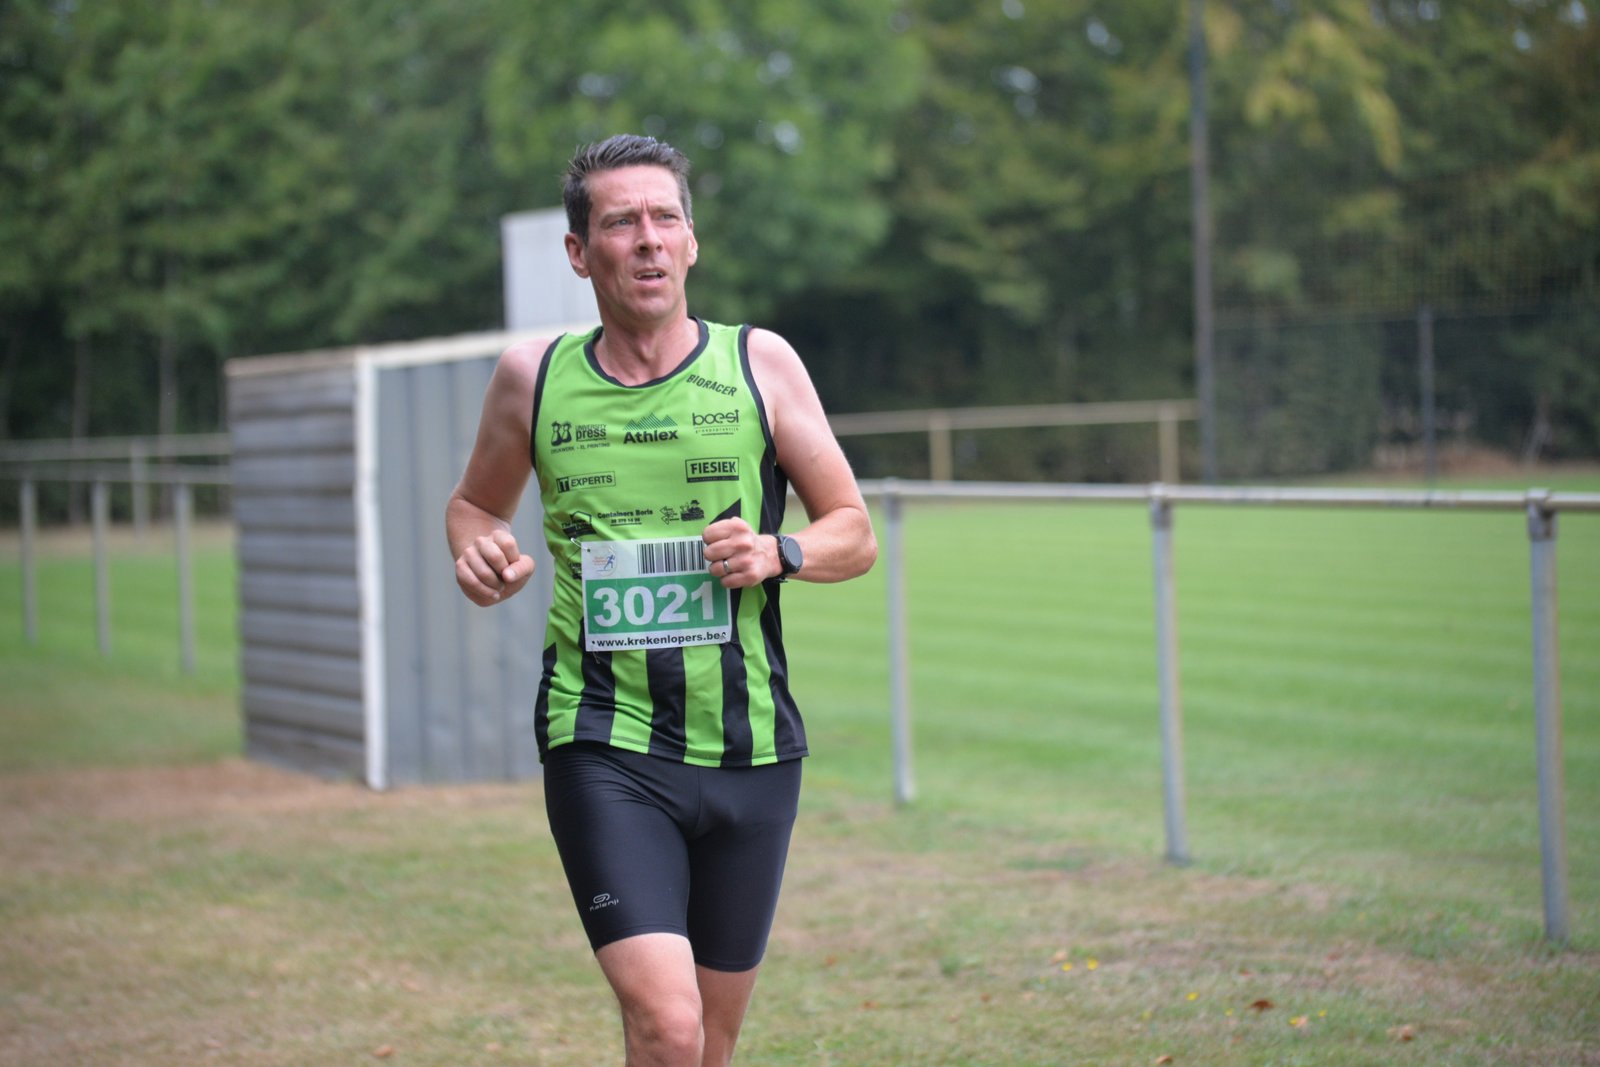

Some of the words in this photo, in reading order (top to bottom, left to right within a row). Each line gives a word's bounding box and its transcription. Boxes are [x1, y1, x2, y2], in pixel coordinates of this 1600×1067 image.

[687, 374, 737, 397] BIORACER
[576, 428, 606, 441] press
[623, 429, 679, 444] Athlex
[690, 461, 736, 475] FIESIEK
[571, 475, 613, 487] EXPERTS
[597, 510, 634, 519] Containers
[593, 581, 715, 627] 3021
[597, 631, 720, 647] www.krekenlopers.be
